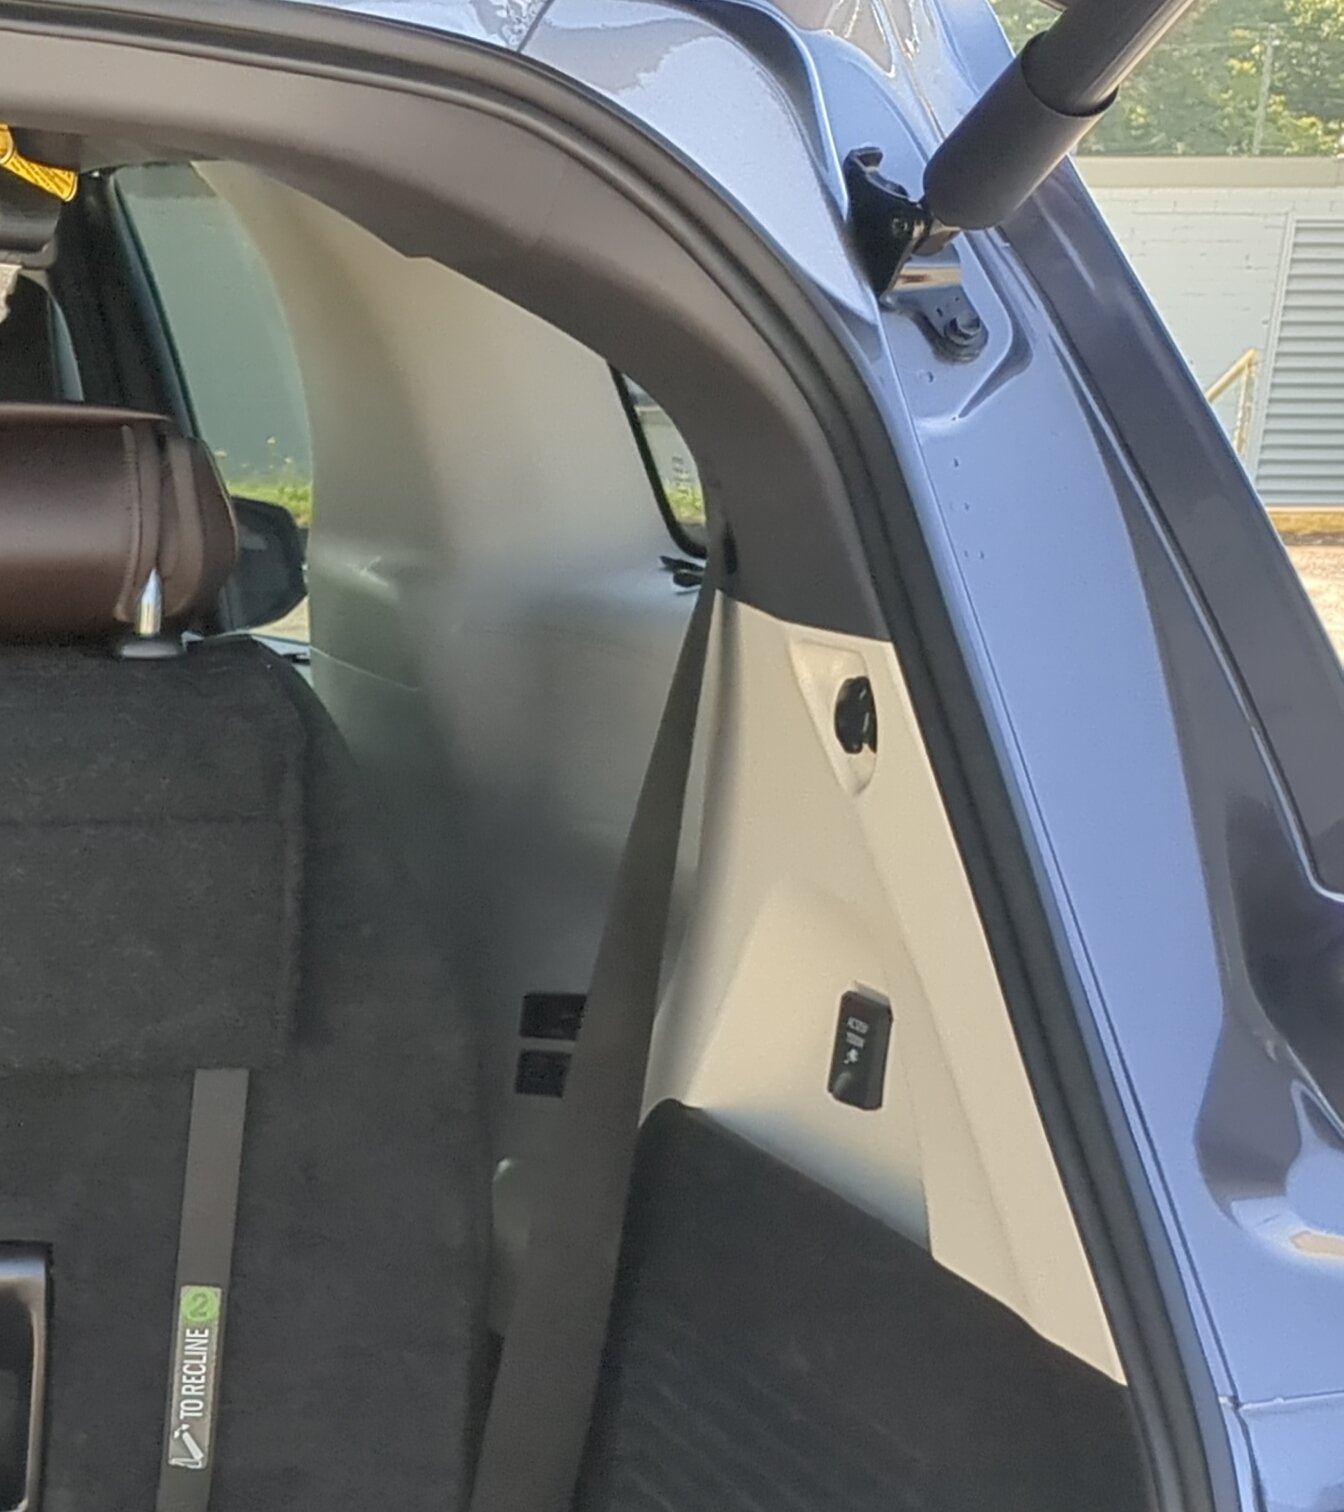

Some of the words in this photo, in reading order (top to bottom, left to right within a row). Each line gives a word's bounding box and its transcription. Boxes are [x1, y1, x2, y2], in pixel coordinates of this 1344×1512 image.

[189, 1292, 209, 1318] 2
[181, 1327, 210, 1396] RECLINE
[179, 1399, 205, 1420] TO
